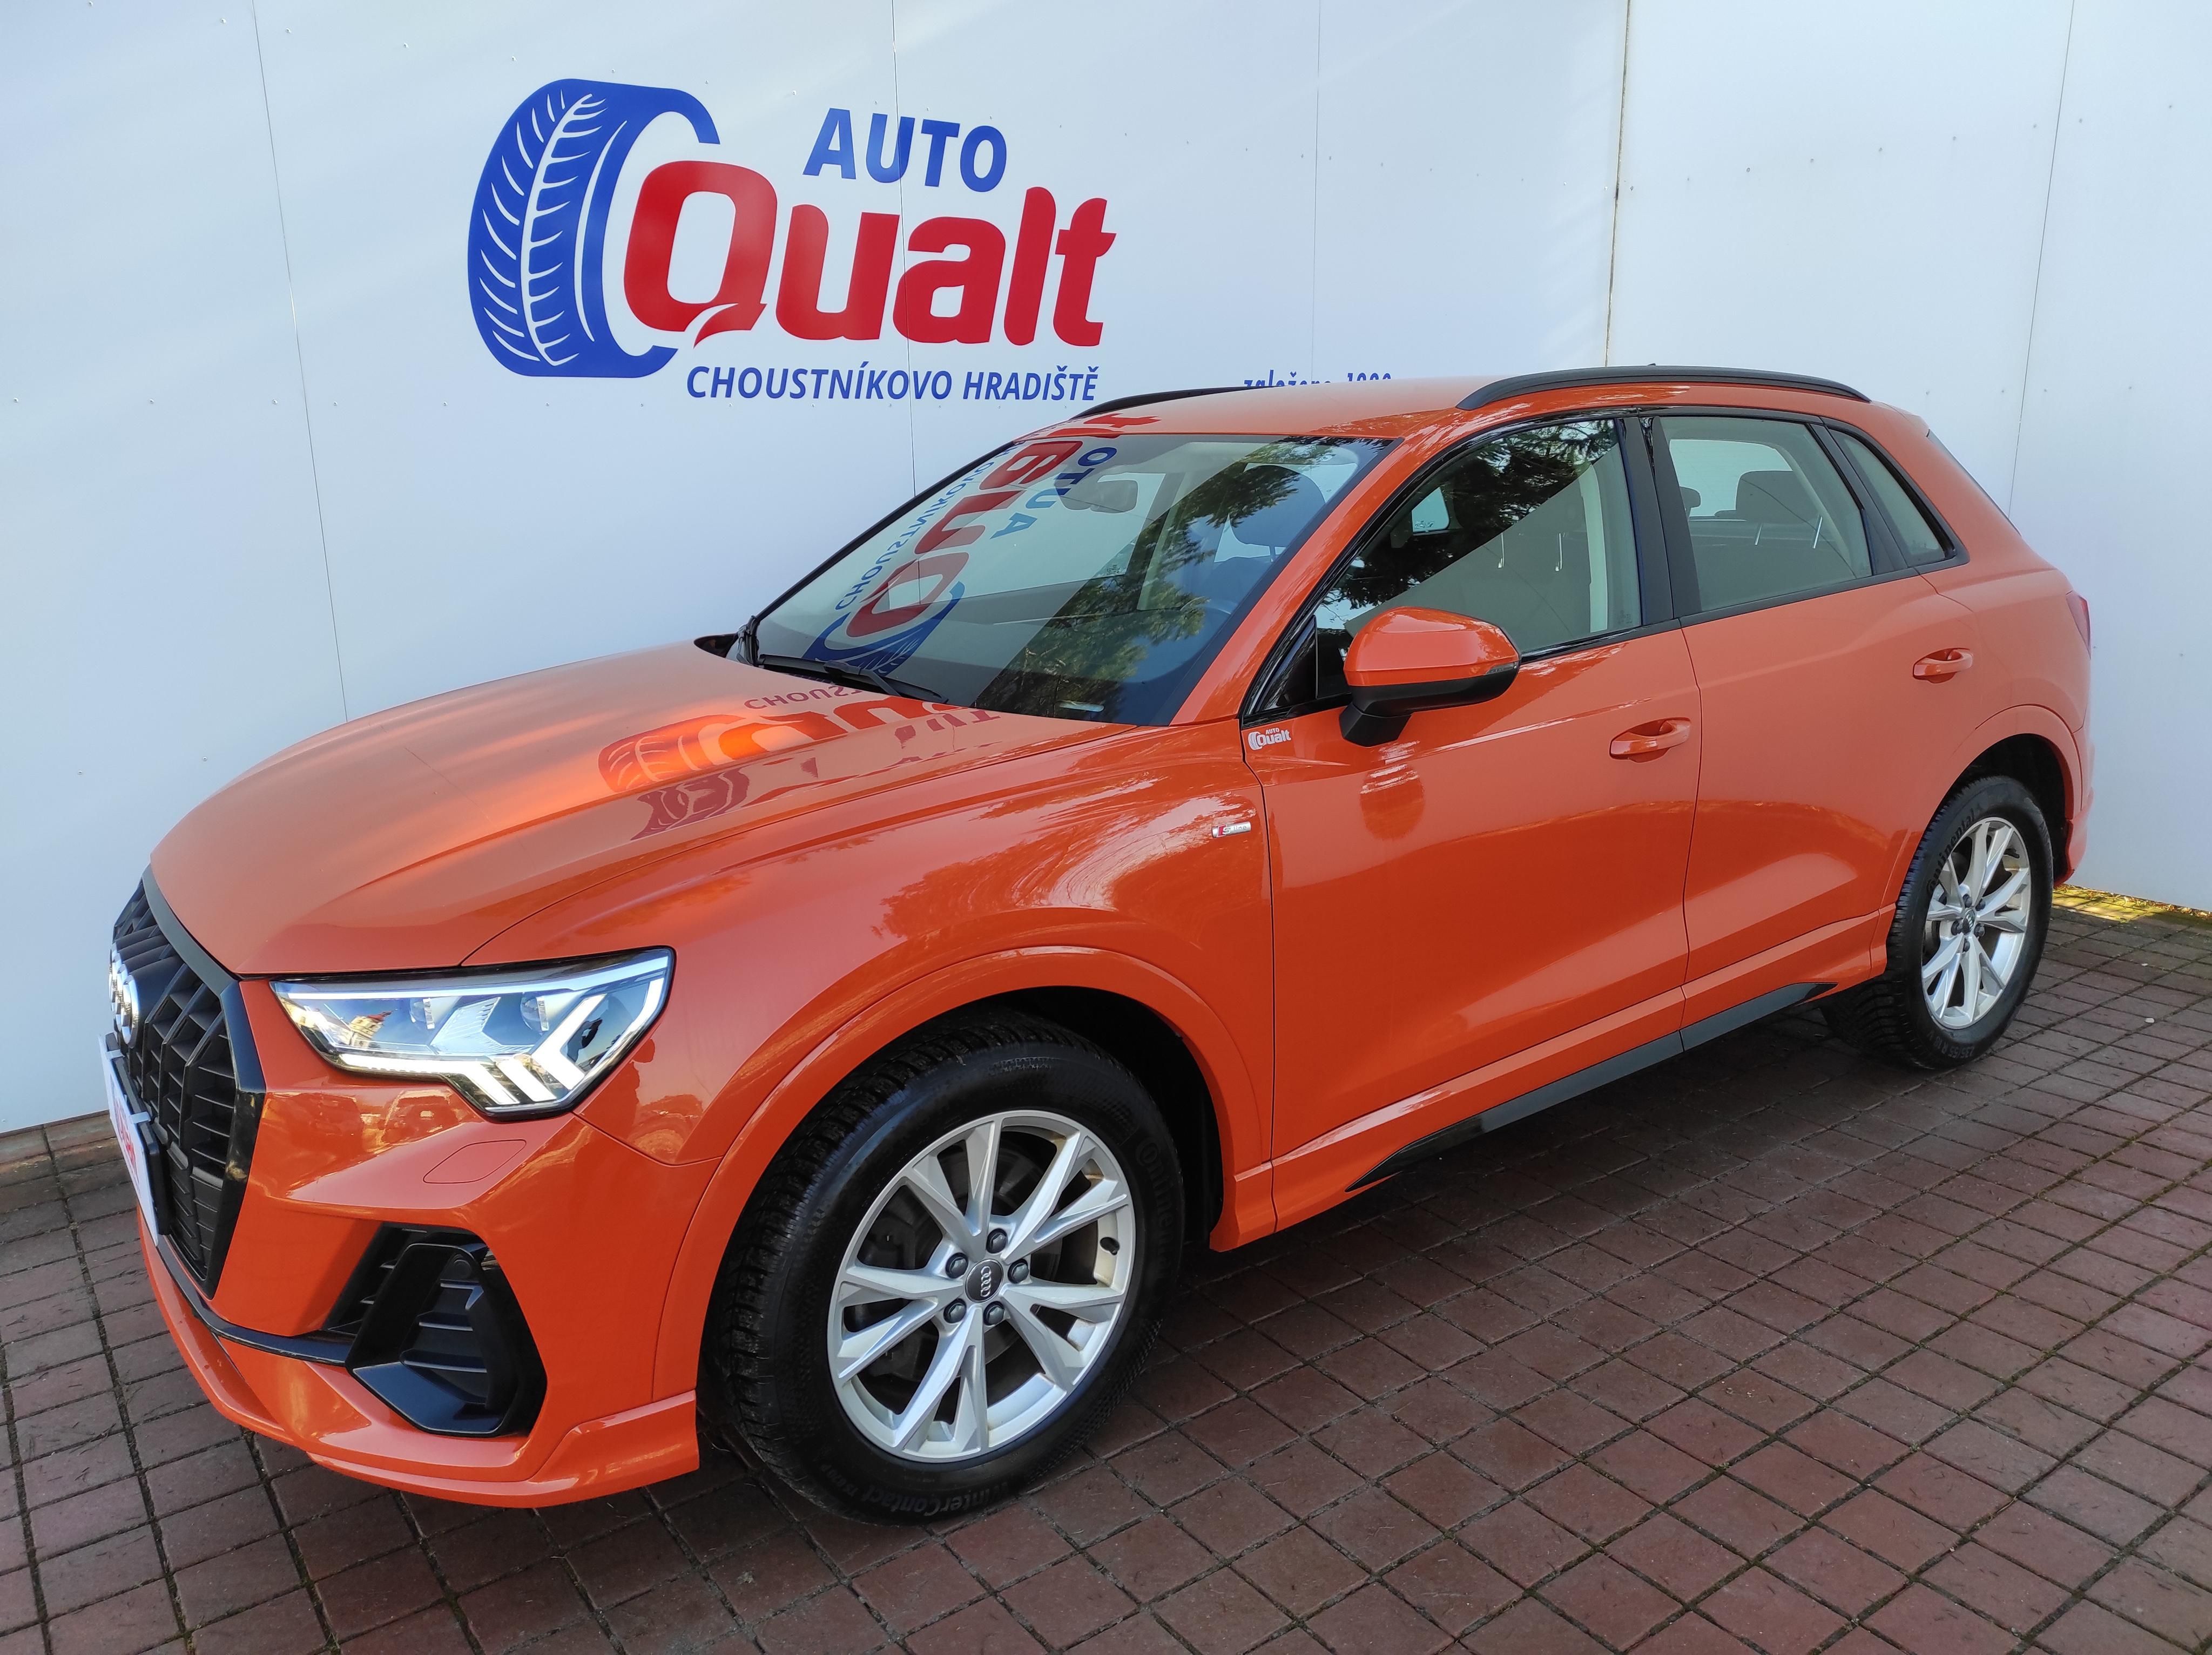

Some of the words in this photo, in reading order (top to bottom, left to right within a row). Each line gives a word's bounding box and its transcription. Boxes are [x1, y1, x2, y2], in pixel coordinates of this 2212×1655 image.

[802, 107, 1007, 193] AUTO
[623, 160, 1116, 347] Qualt
[686, 360, 953, 401] CHOUSTNÍKOVO
[962, 364, 1100, 401] HRADIŠTĚ
[1257, 729, 1292, 746] Qualt
